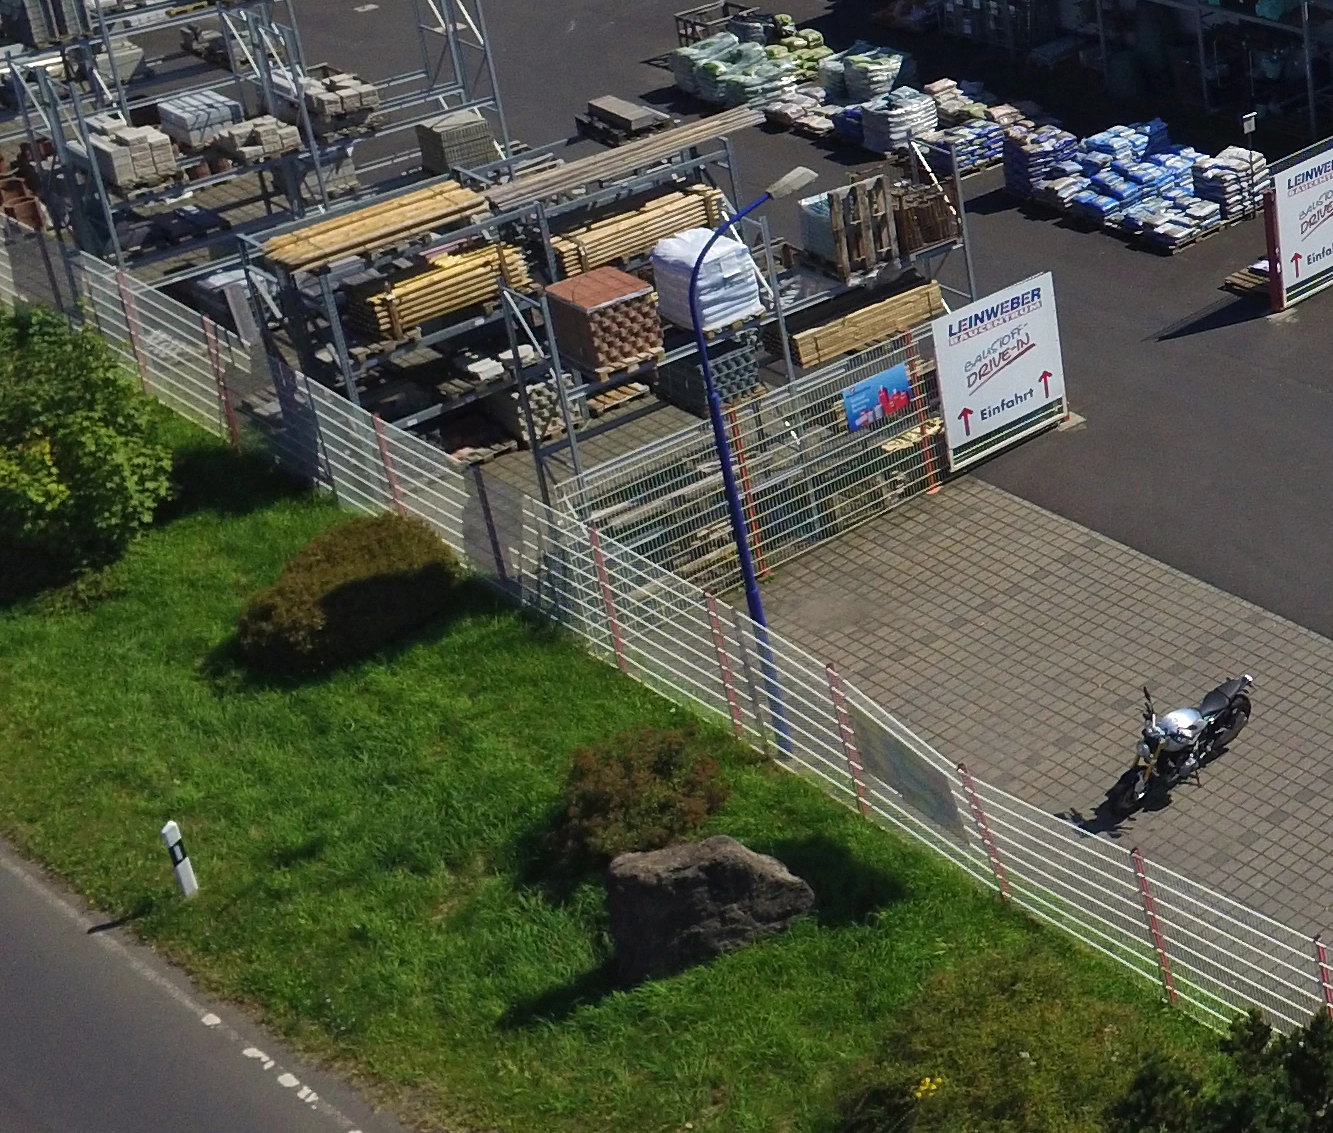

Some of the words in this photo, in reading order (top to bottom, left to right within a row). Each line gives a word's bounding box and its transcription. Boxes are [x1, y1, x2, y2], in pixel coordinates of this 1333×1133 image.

[948, 287, 1041, 338] LEINWEBER
[967, 333, 1031, 388] DRIVE-IN
[981, 388, 1034, 420] Einfahrt
